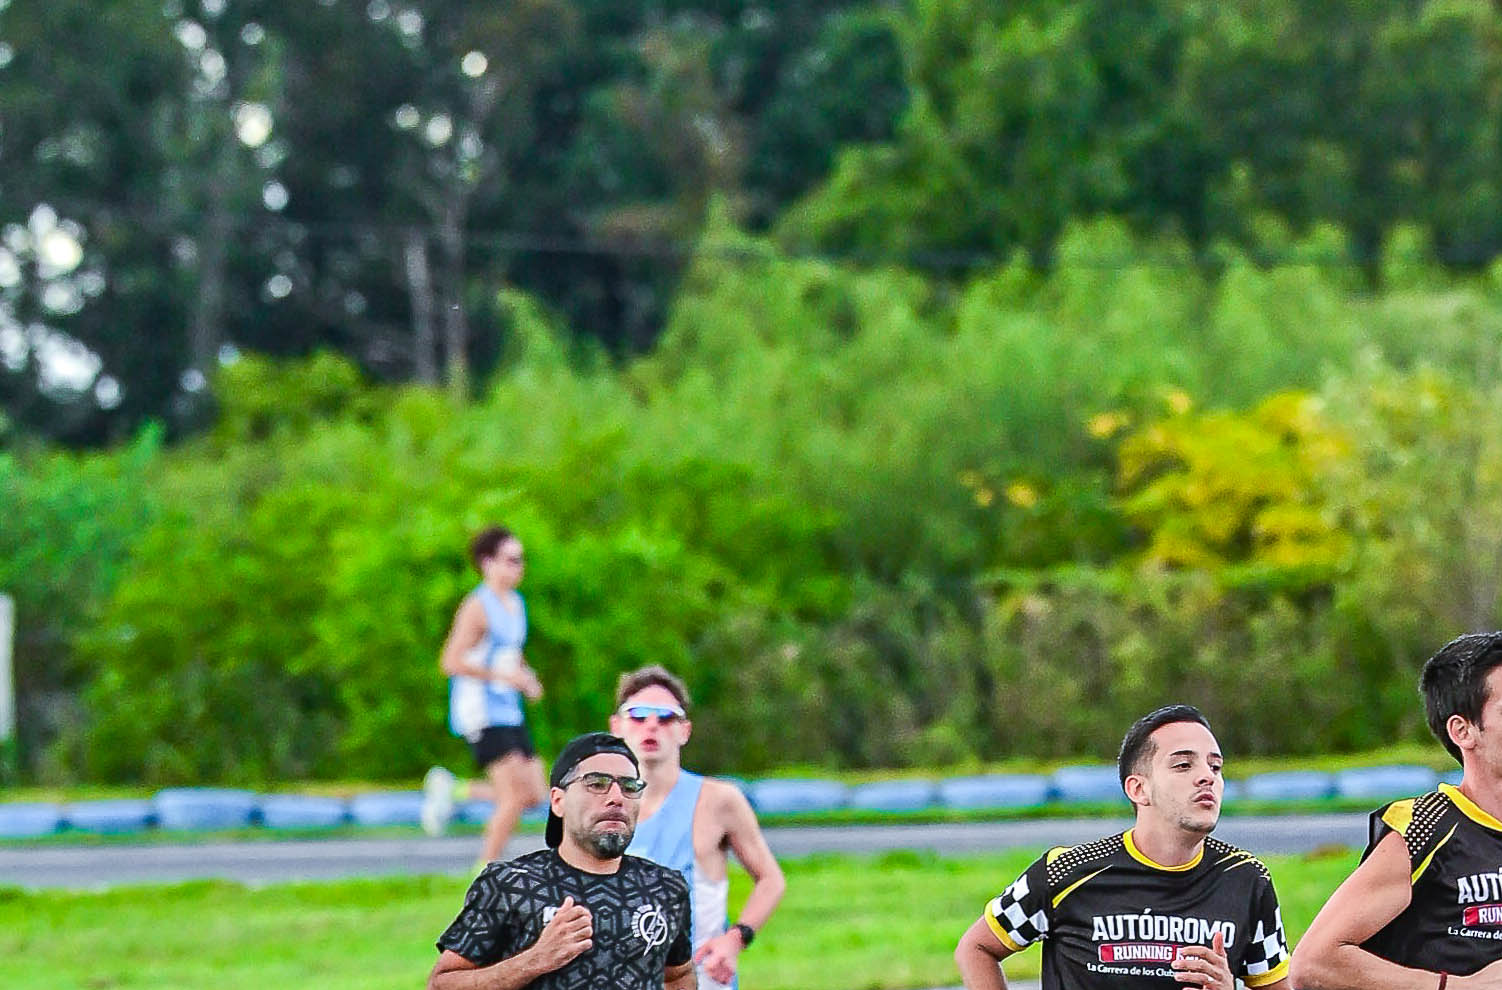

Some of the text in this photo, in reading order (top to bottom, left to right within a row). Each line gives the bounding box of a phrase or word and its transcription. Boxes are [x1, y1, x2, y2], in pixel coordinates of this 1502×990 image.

[1092, 908, 1236, 948] AUTÓDROMO
[1448, 926, 1459, 935] La
[1460, 928, 1491, 938] Carrera
[1113, 944, 1173, 961] RUNNING
[1086, 962, 1177, 978] La Carrera de los Club
